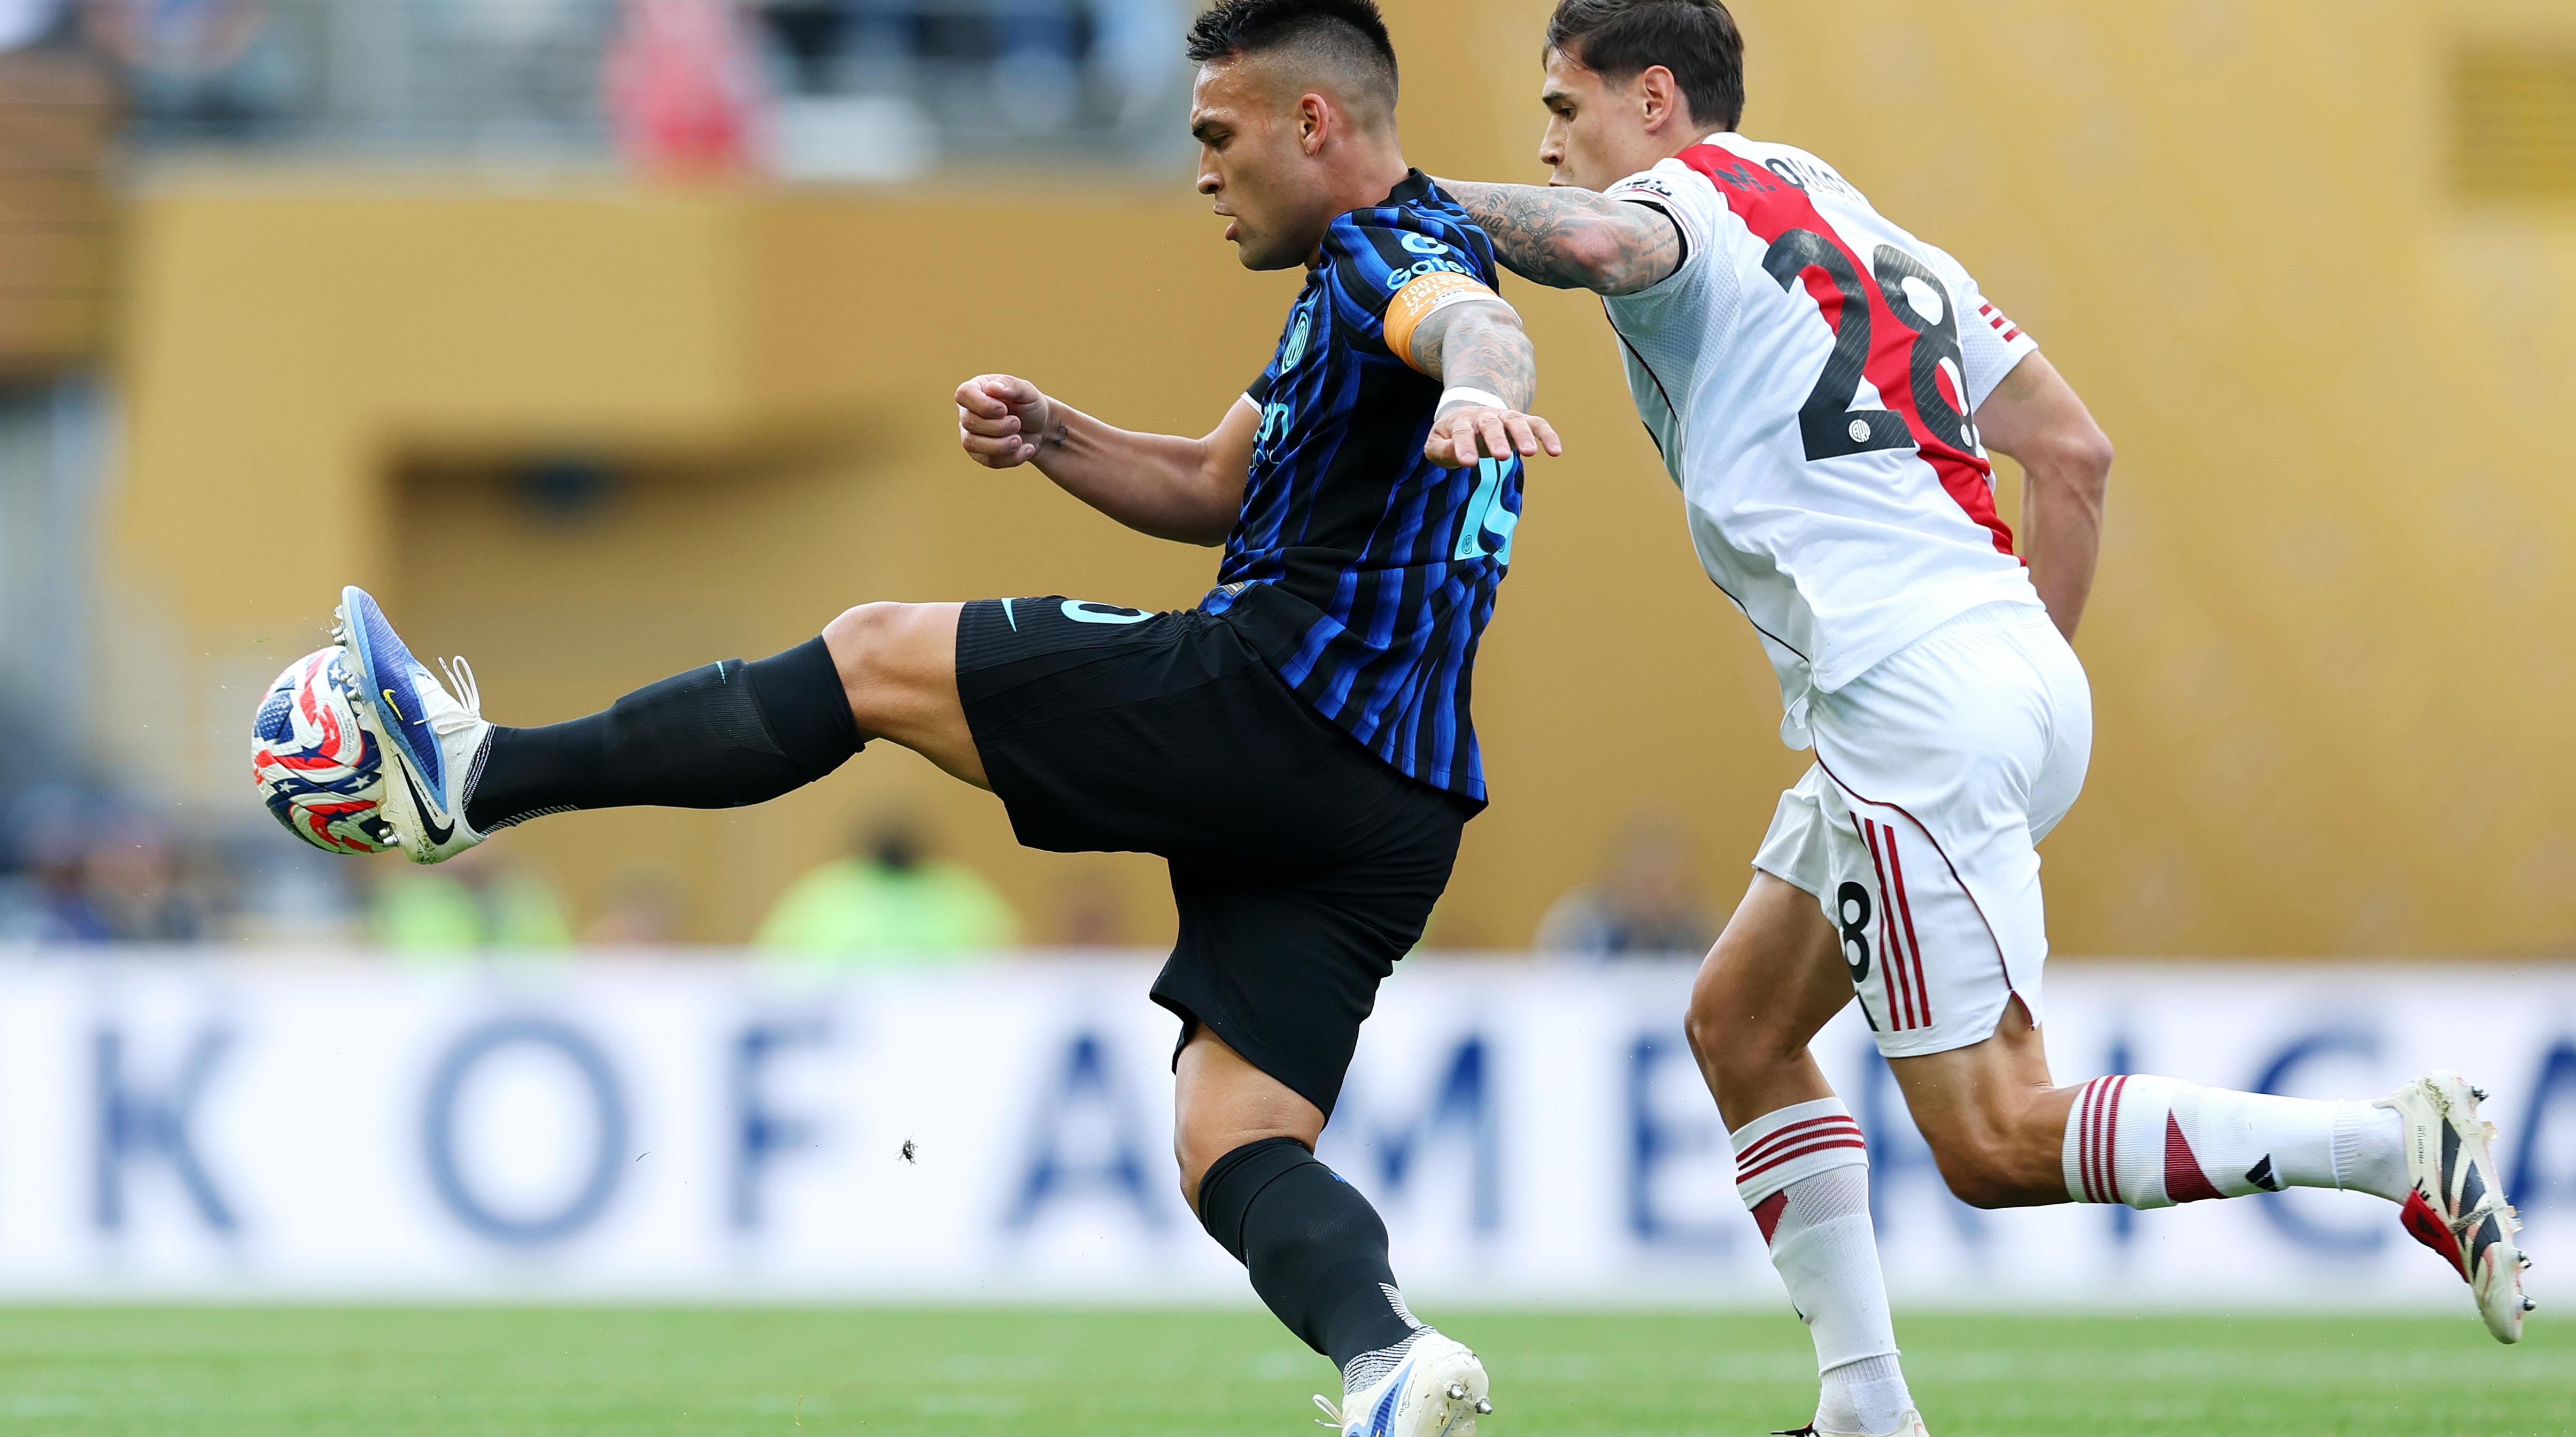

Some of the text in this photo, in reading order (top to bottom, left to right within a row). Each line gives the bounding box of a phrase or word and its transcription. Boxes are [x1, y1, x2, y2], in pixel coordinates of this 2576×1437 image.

[1400, 274, 1474, 302] FOOTBA
[1761, 228, 1977, 462] 28
[418, 1013, 839, 1247] OF
